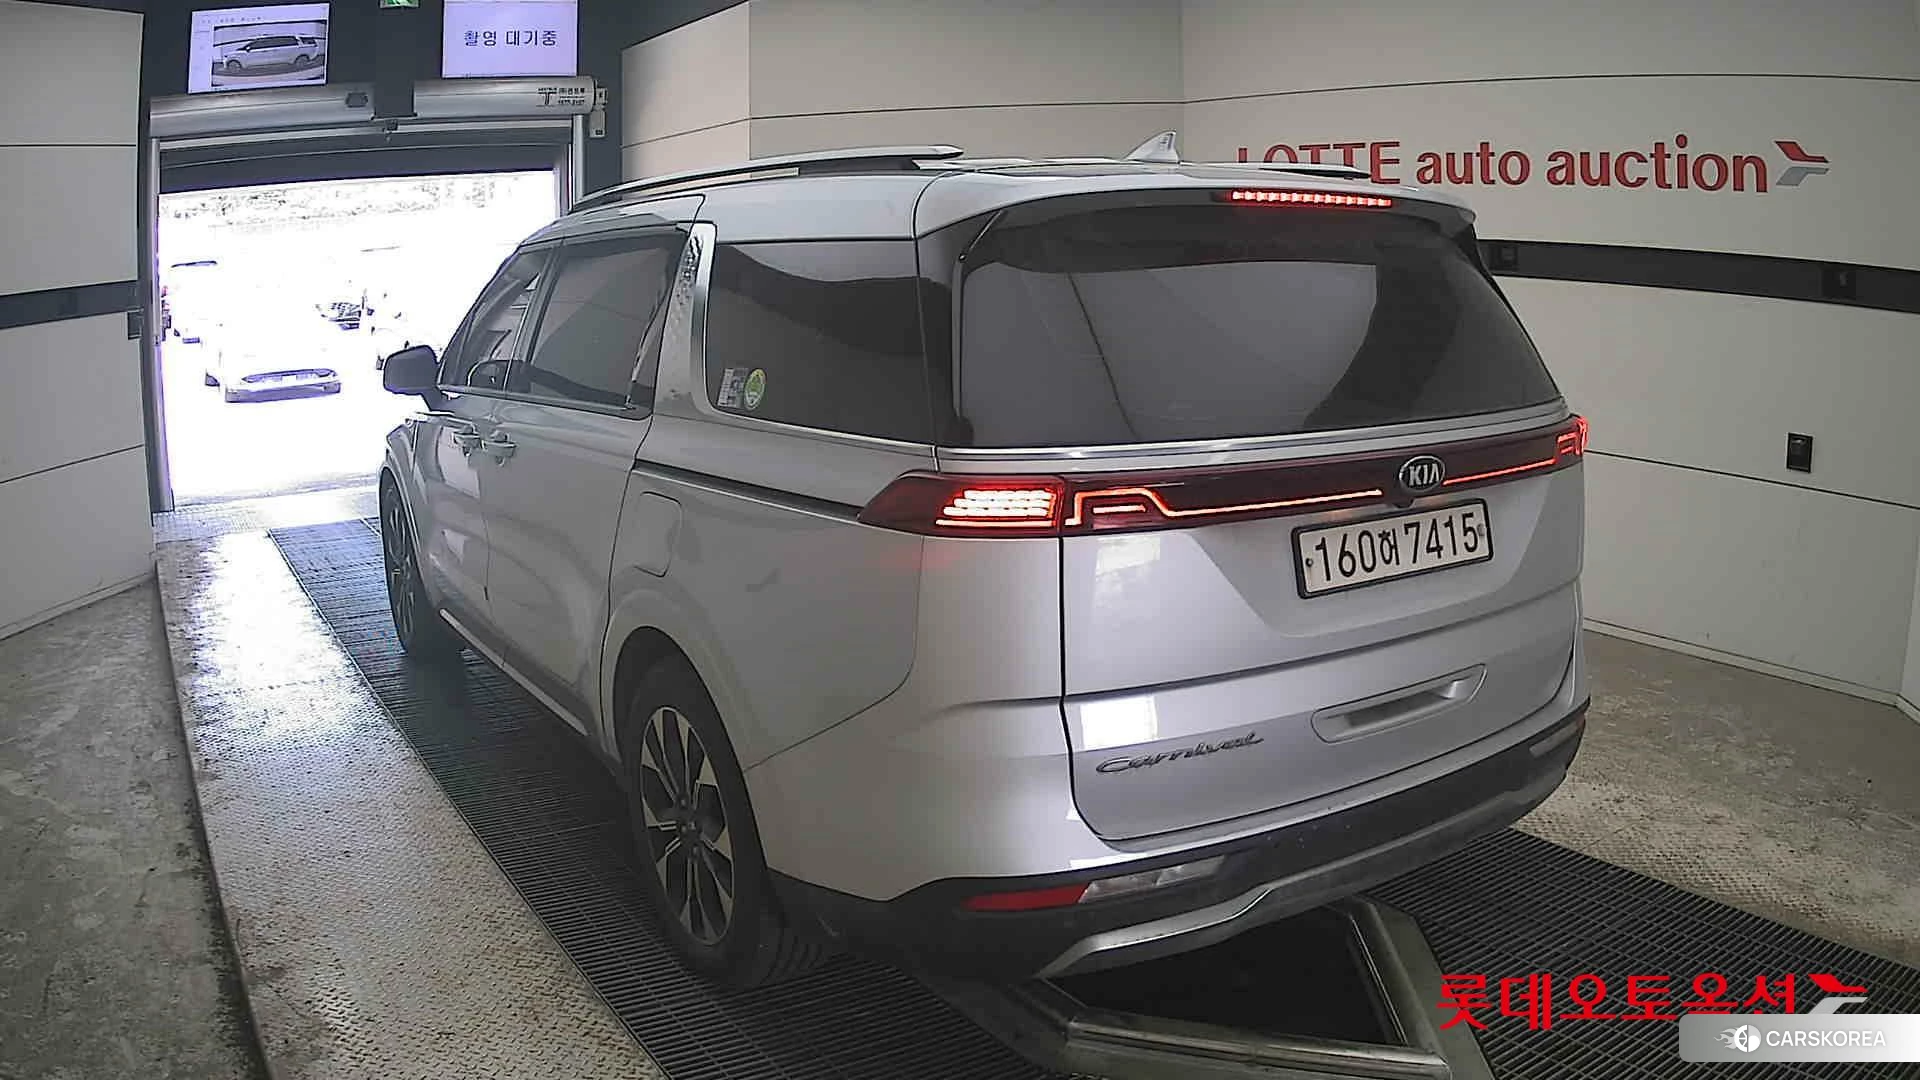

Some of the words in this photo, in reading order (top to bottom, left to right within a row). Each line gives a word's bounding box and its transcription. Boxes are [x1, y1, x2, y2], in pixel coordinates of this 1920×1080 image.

[505, 30, 557, 46] 대기중
[1416, 142, 1531, 186] auto
[1546, 134, 1768, 193] auction
[1409, 464, 1440, 487] KIA
[1096, 733, 1264, 772] Carnival
